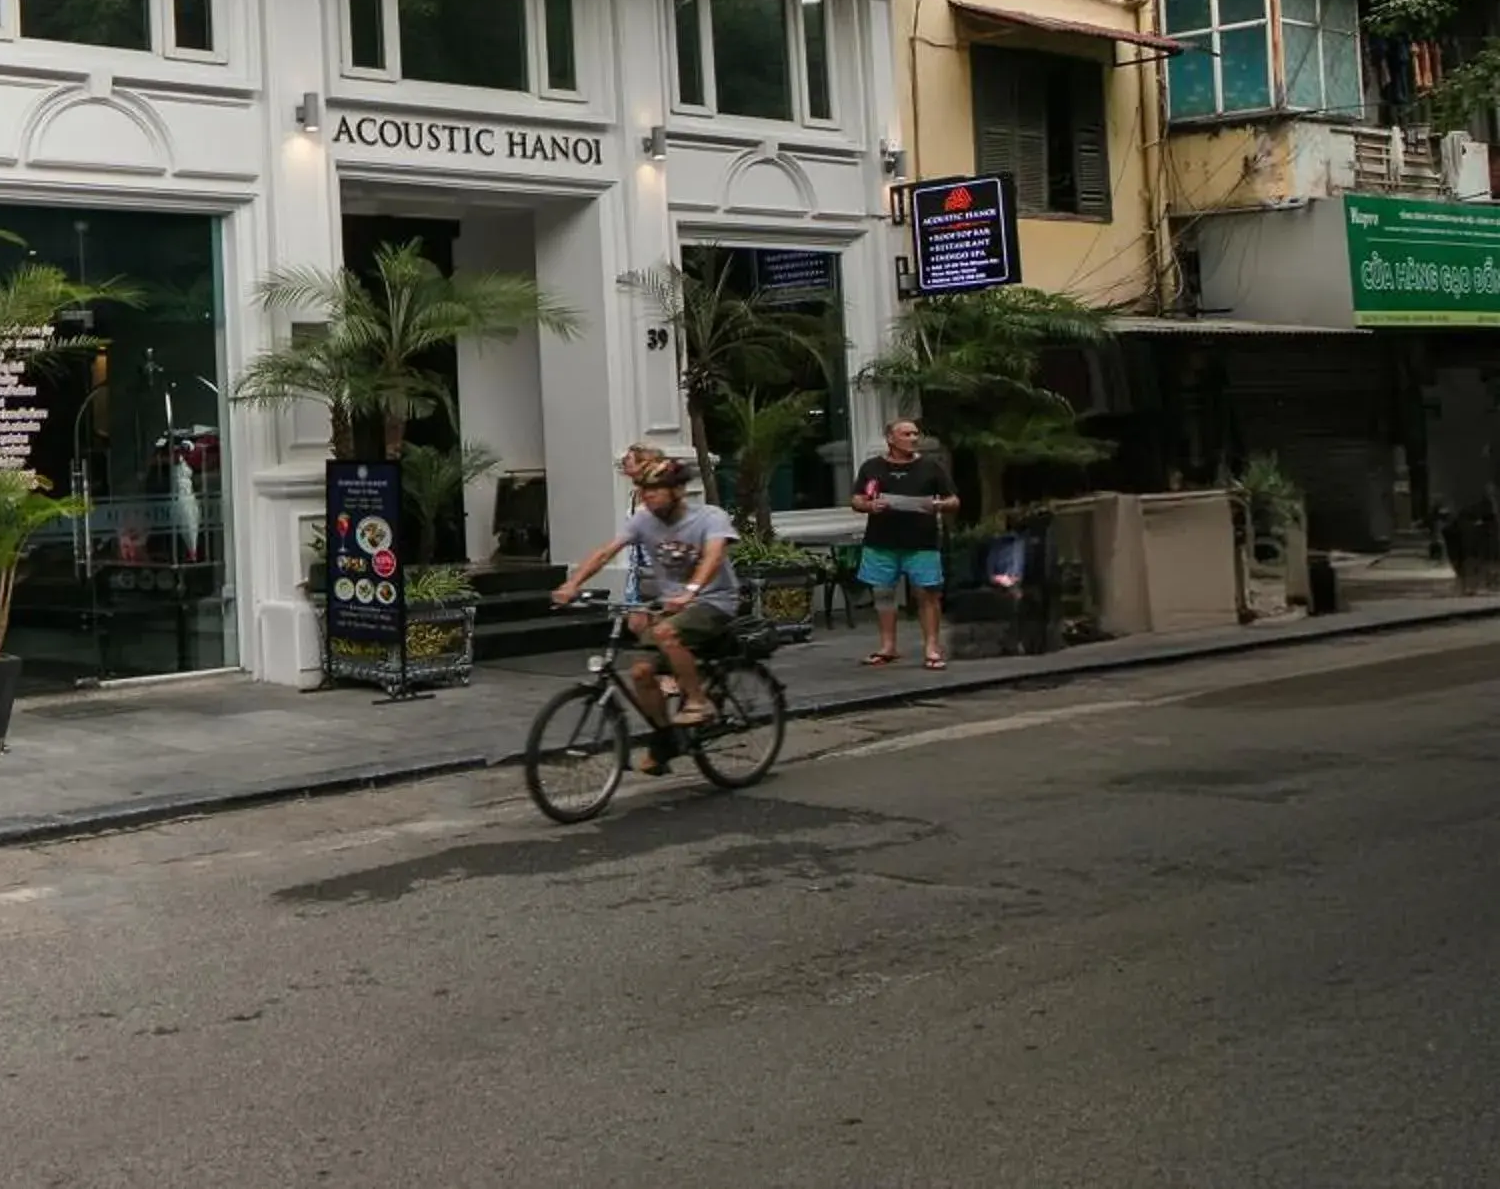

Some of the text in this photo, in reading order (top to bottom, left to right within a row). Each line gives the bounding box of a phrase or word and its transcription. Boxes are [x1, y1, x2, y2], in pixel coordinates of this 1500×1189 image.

[332, 114, 604, 165] ACOUSTIC HANOI
[647, 328, 669, 350] 39
